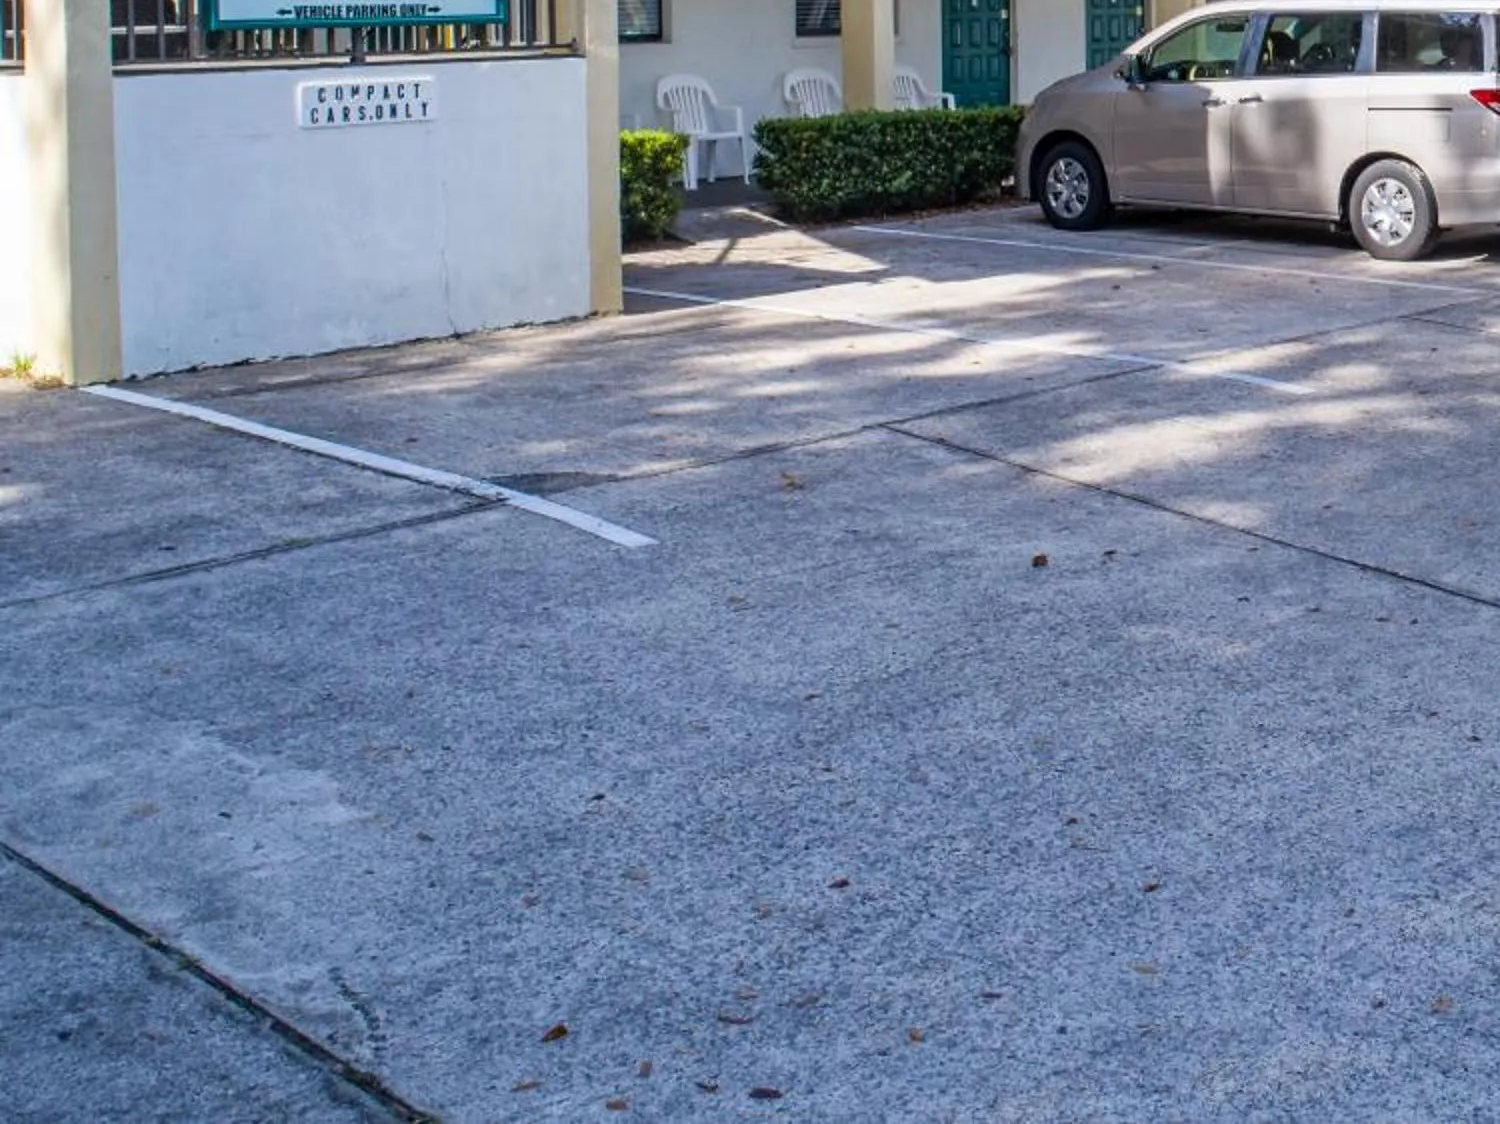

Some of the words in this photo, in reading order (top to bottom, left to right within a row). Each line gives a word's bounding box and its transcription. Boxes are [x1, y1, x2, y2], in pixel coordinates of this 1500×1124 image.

[294, 5, 343, 19] VEHICLE
[345, 4, 396, 18] PARKING
[399, 3, 427, 17] ONLY
[317, 83, 421, 103] COMPACT
